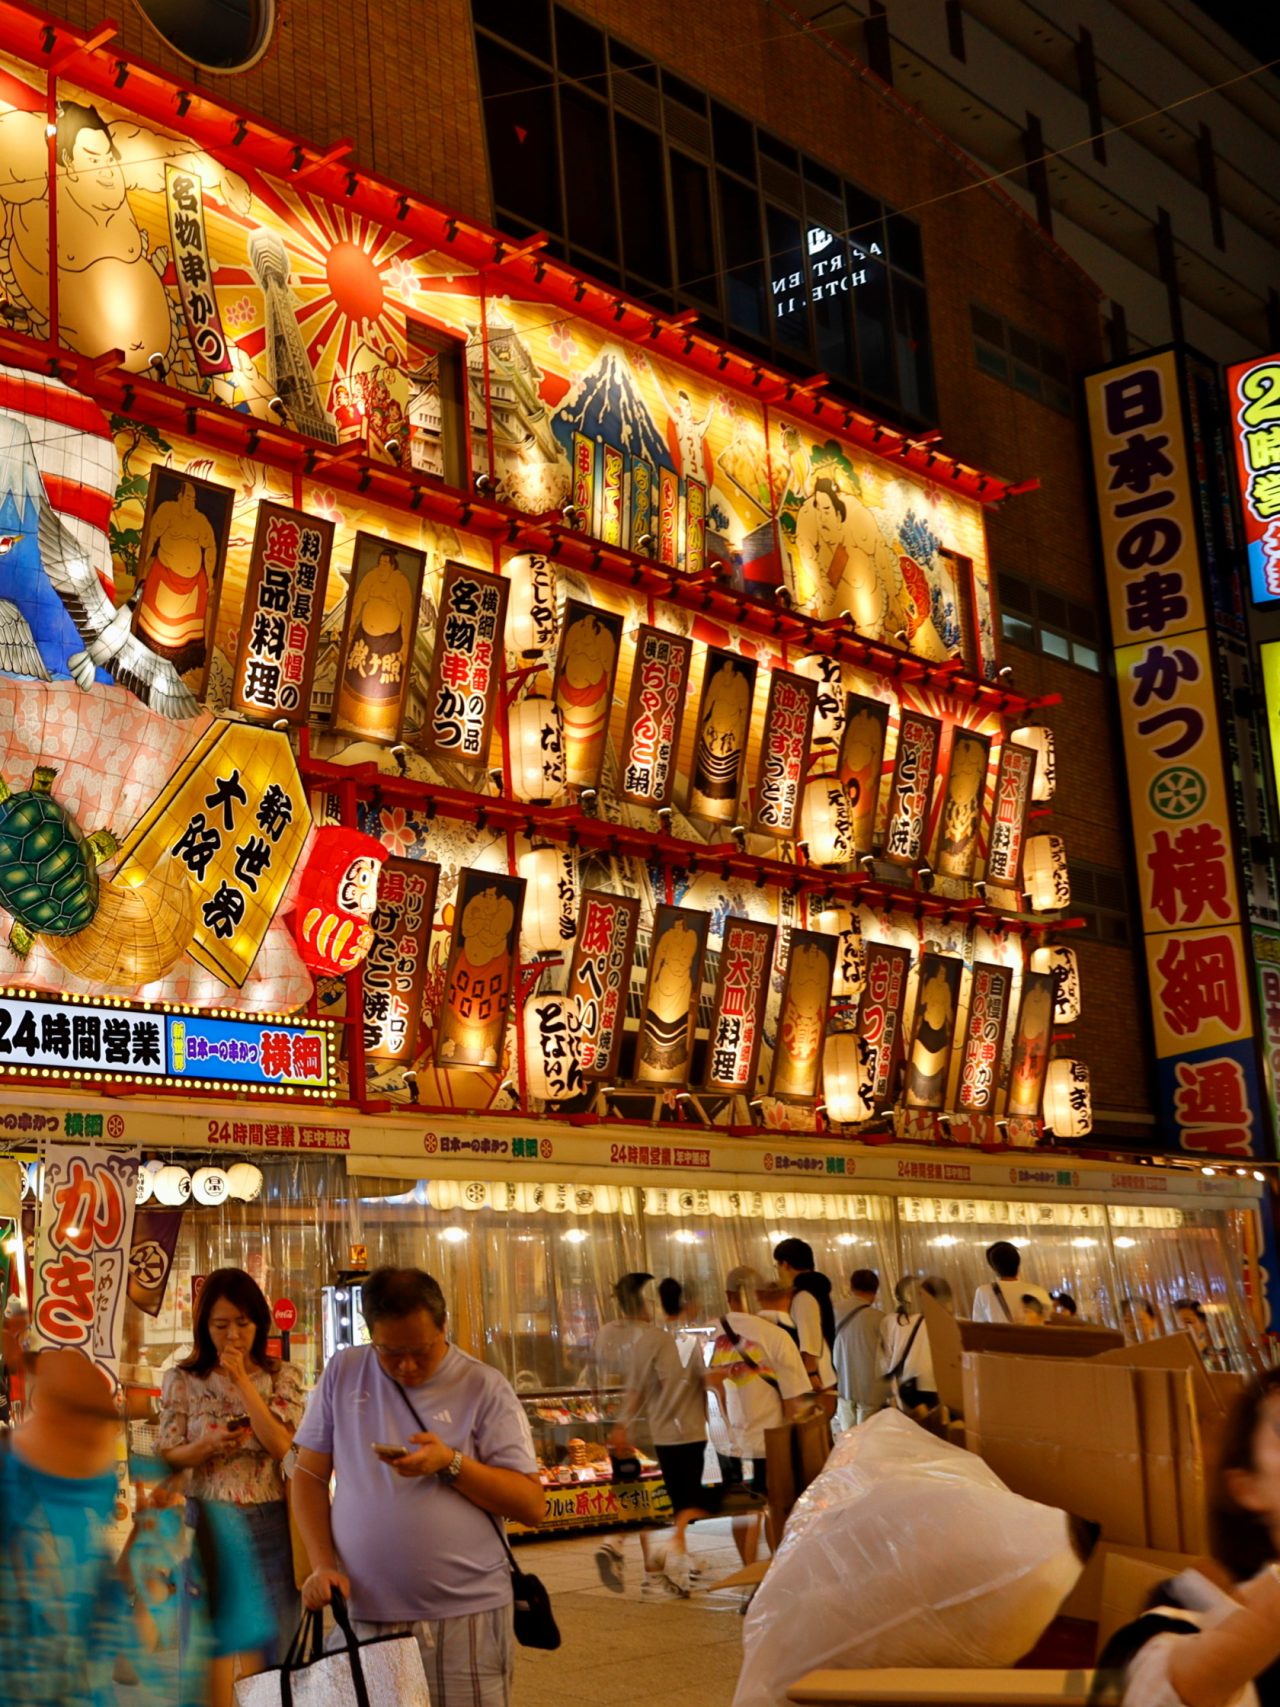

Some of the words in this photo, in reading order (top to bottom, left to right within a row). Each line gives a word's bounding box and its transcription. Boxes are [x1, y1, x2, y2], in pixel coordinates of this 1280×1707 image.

[172, 175, 227, 365] 名物串かつ
[244, 516, 301, 709] 逸品料理
[280, 529, 322, 709] 料理長自慢の
[1104, 369, 1207, 760] 日本一の串かつ
[433, 578, 482, 749] 名物串かつ
[462, 585, 500, 753] 横綱定番の一品
[624, 661, 666, 797] ちゃんこ鍋
[202, 783, 294, 940] 新世界
[1147, 822, 1243, 1037] 横綱
[186, 1036, 259, 1063] 日本一の串かつ
[259, 1030, 324, 1081] 横綱
[595, 905, 631, 1073] なにわの鉄板焼き
[710, 952, 752, 1084] 大皿料理
[63, 1112, 105, 1138] 横綱
[207, 1119, 296, 1147] 24時間営業
[298, 1126, 351, 1149] 年中無休
[439, 1136, 509, 1155] 日本一の串かつ
[610, 1144, 672, 1166] 24時間営業
[38, 1163, 122, 1341] かき
